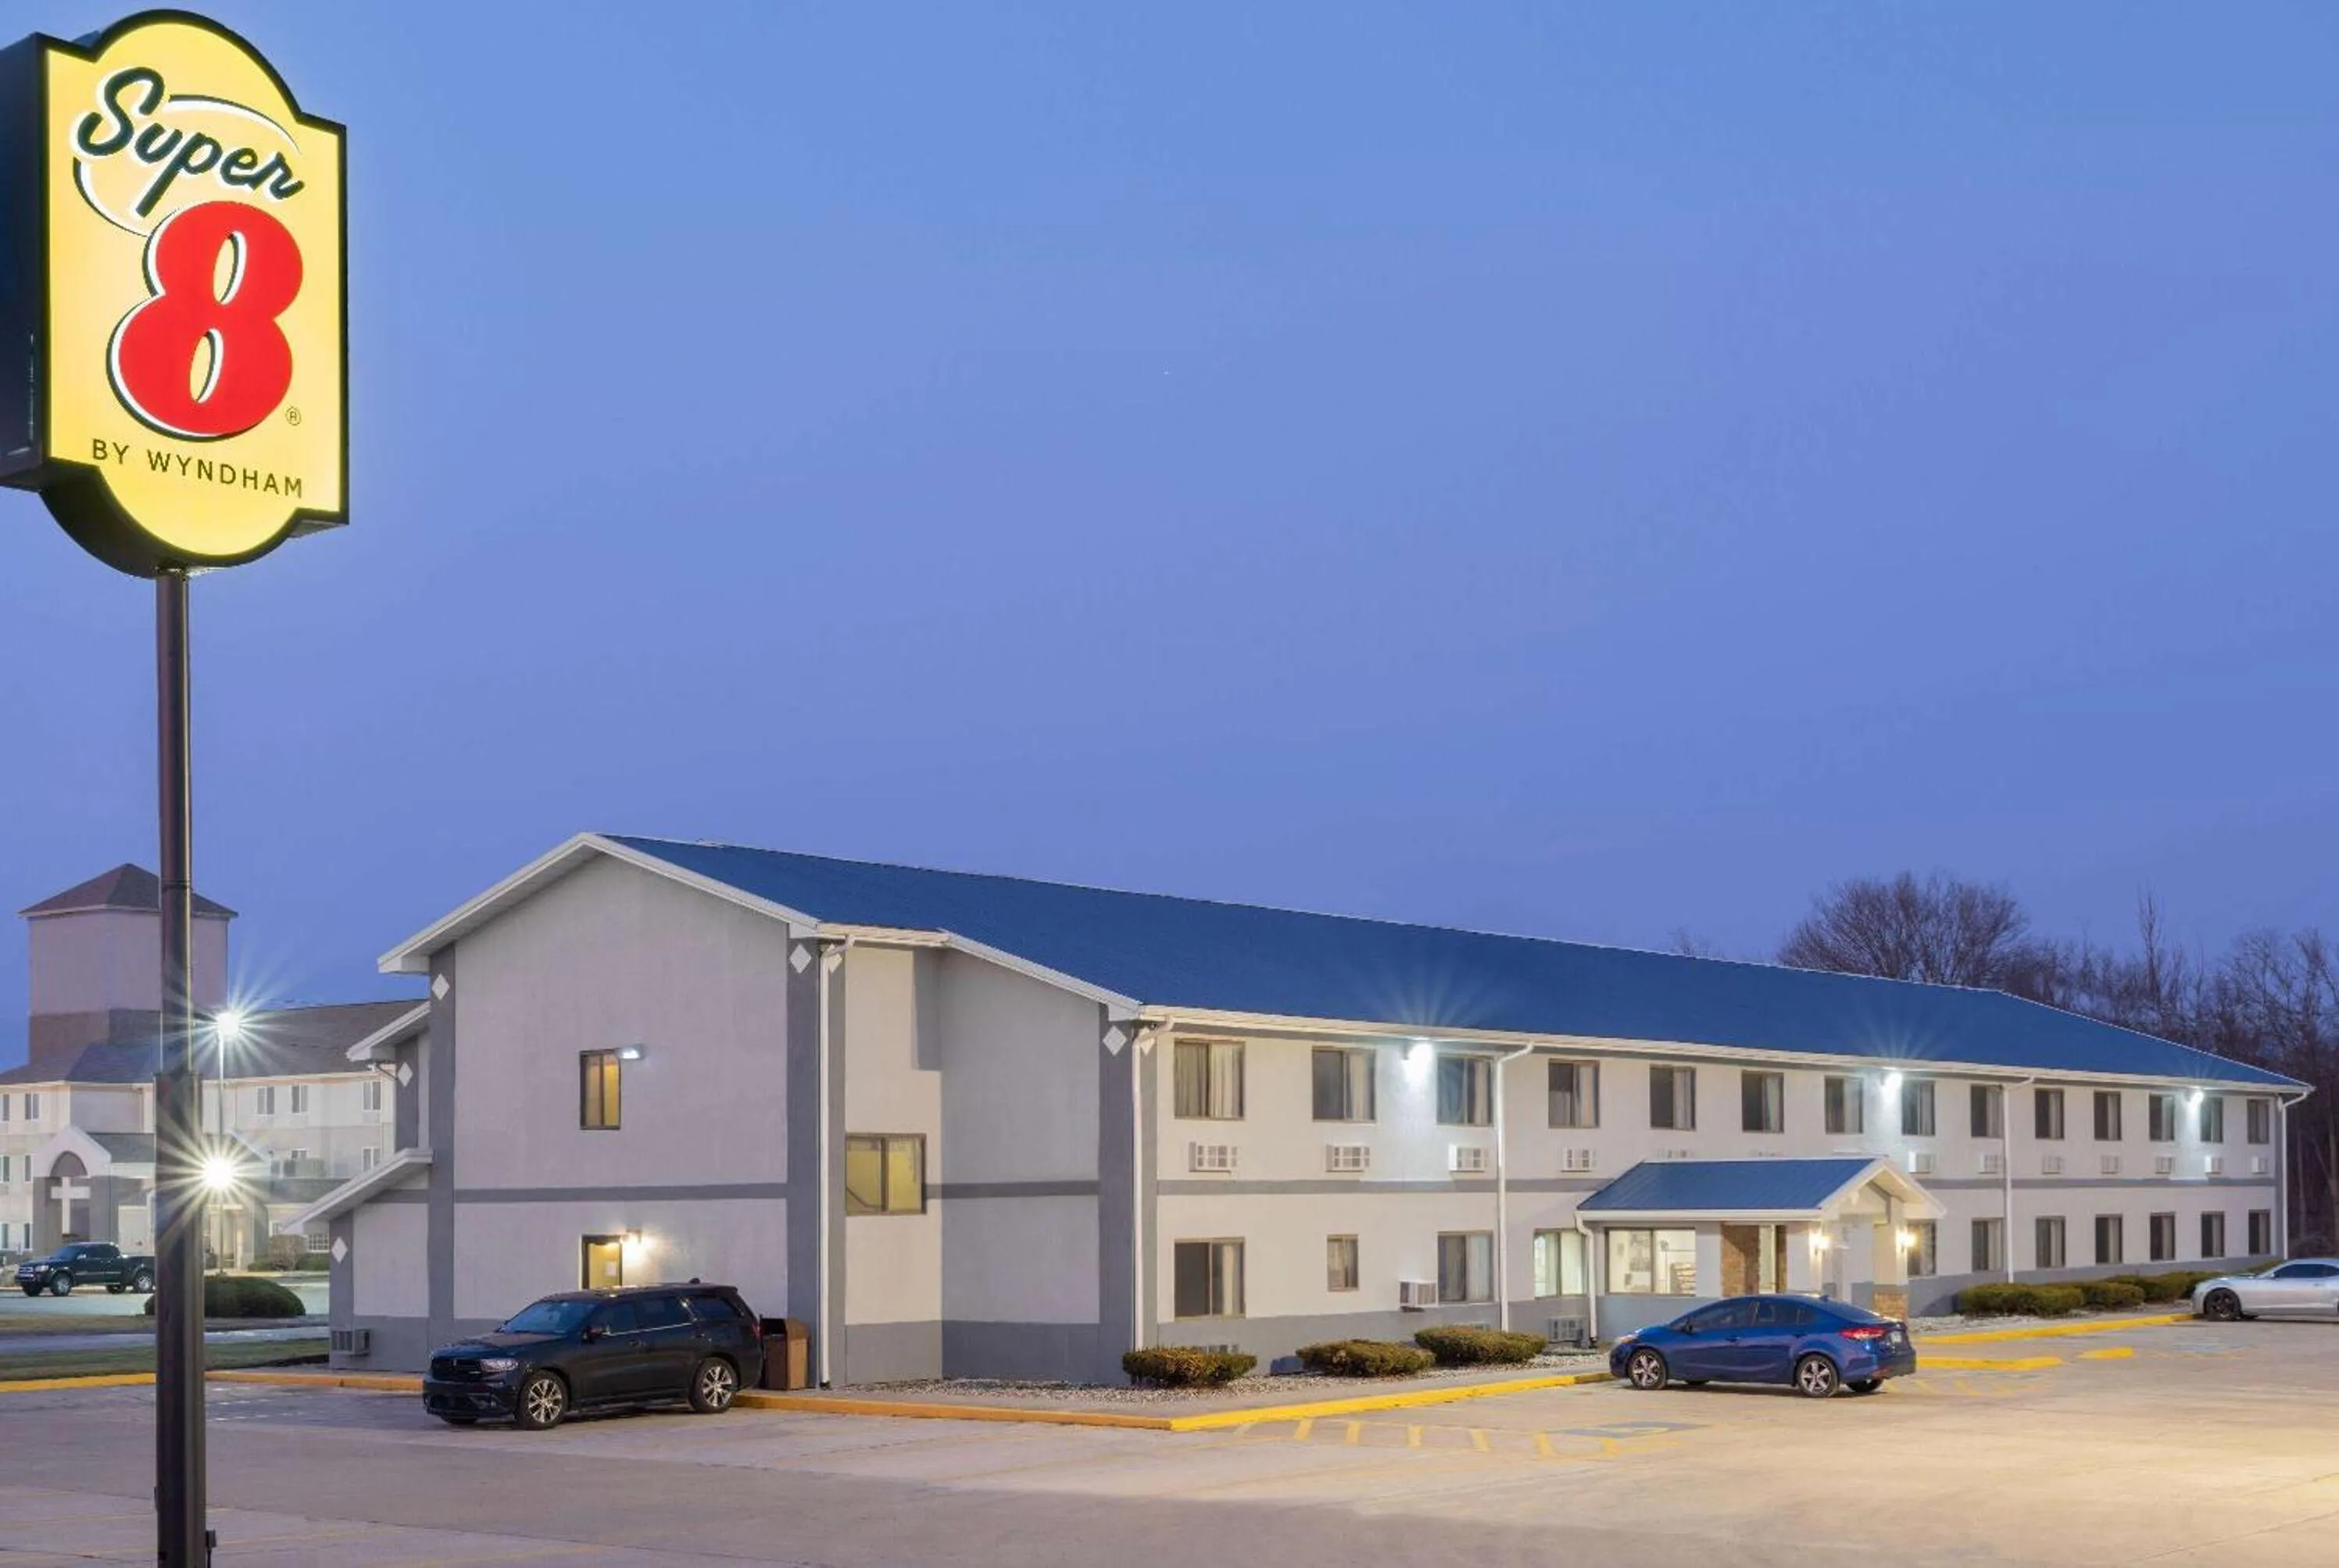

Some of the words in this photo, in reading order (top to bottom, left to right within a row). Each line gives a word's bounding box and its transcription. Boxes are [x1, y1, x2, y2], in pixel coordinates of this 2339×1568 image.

[77, 66, 306, 219] Super
[106, 200, 303, 443] 8
[92, 438, 130, 465] BY
[147, 448, 302, 498] WYNDHAM
